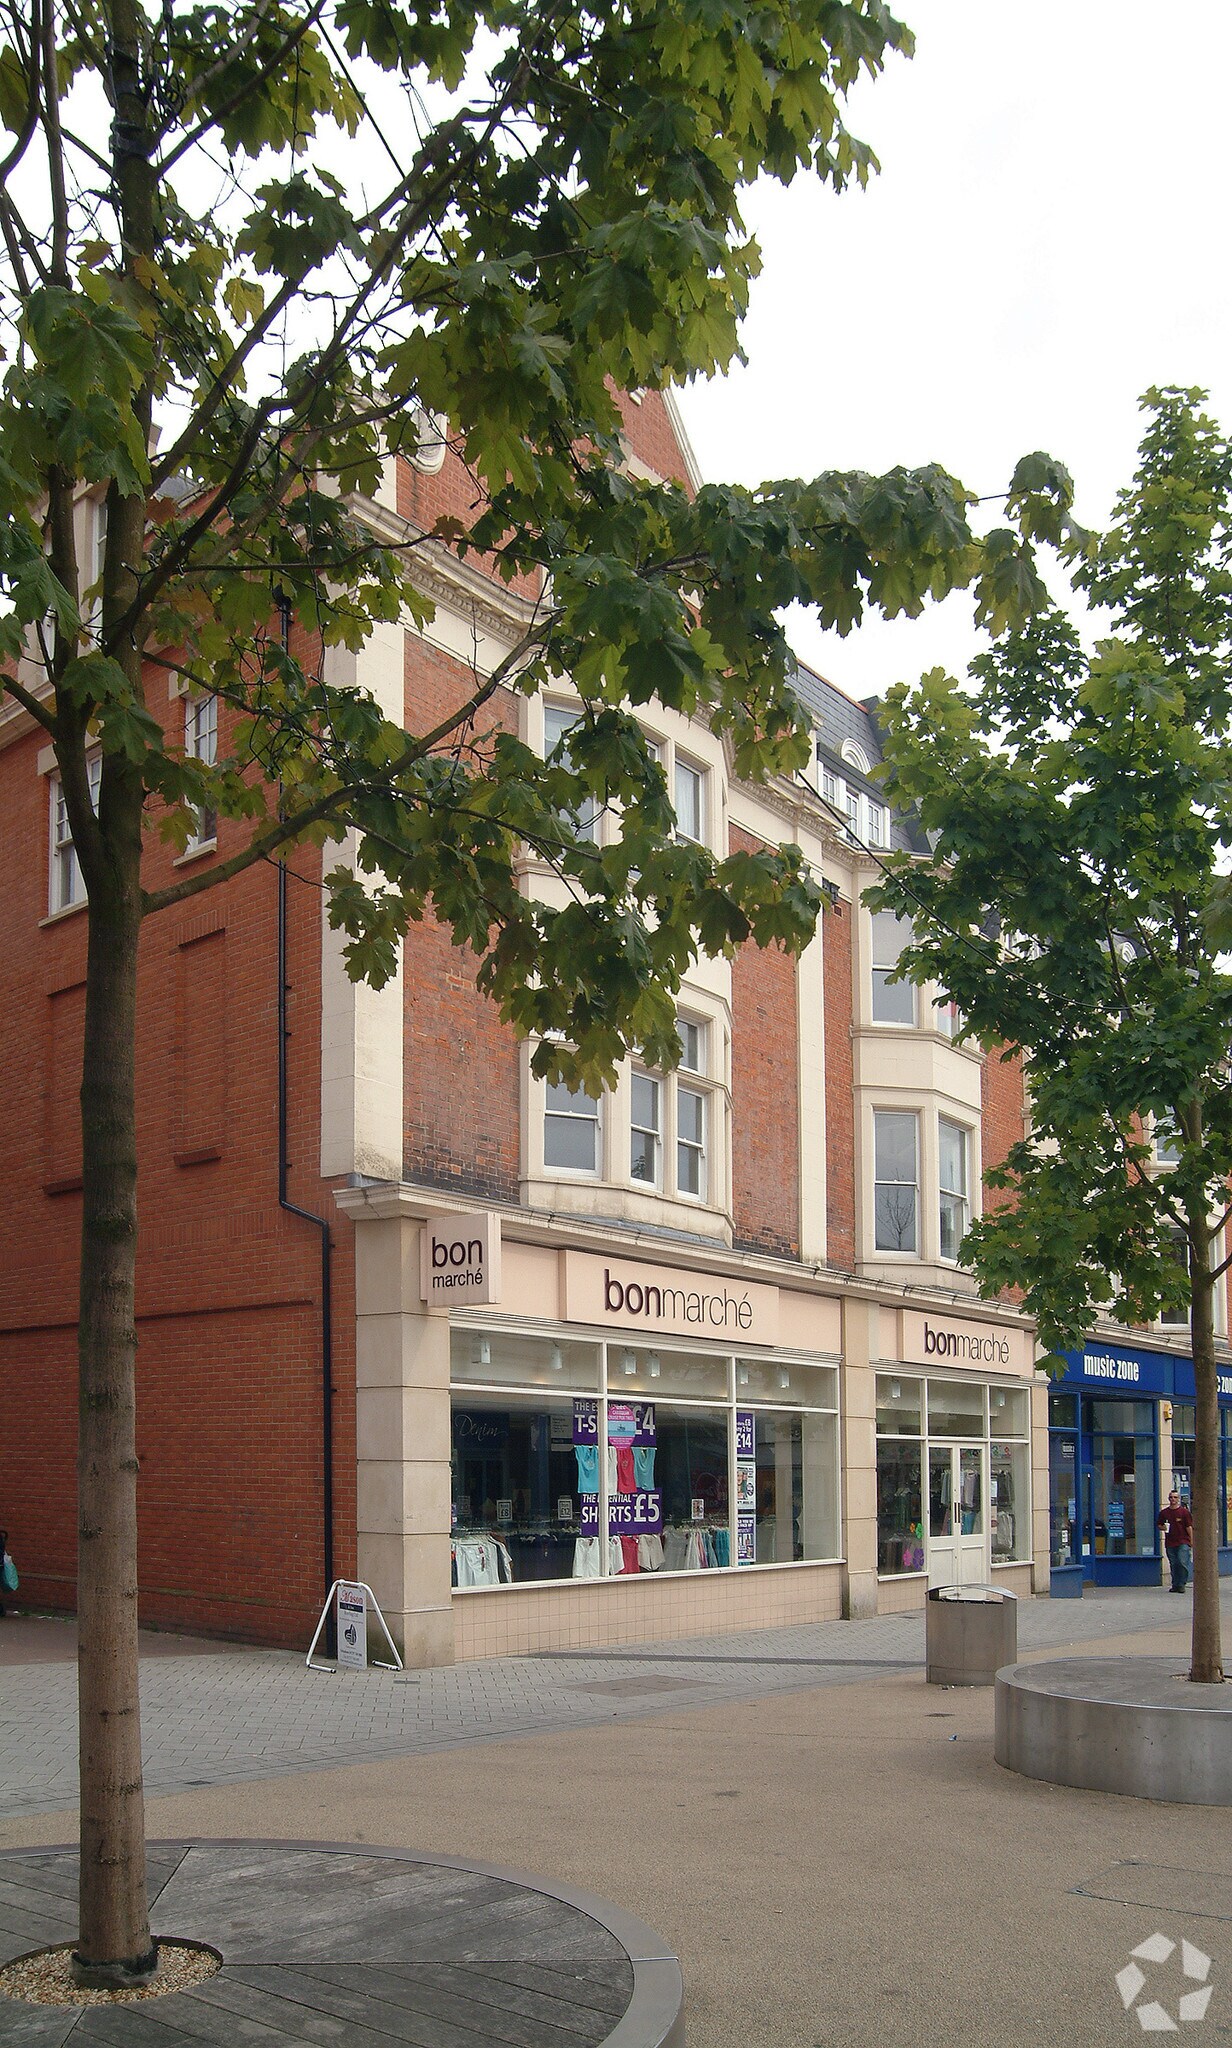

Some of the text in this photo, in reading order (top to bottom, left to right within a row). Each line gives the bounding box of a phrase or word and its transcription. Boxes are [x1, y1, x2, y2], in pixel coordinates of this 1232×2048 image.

[432, 1236, 483, 1268] bon
[432, 1267, 483, 1289] marché
[604, 1268, 753, 1330] bonmarché
[924, 1321, 1009, 1364] bonmarché
[1084, 1353, 1140, 1382] music zone
[575, 1401, 589, 1411] THE
[633, 1404, 656, 1435] £4
[736, 1433, 752, 1448] £14
[583, 1494, 596, 1503] THE
[633, 1494, 660, 1523] £5
[582, 1506, 632, 1523] SHRTS
